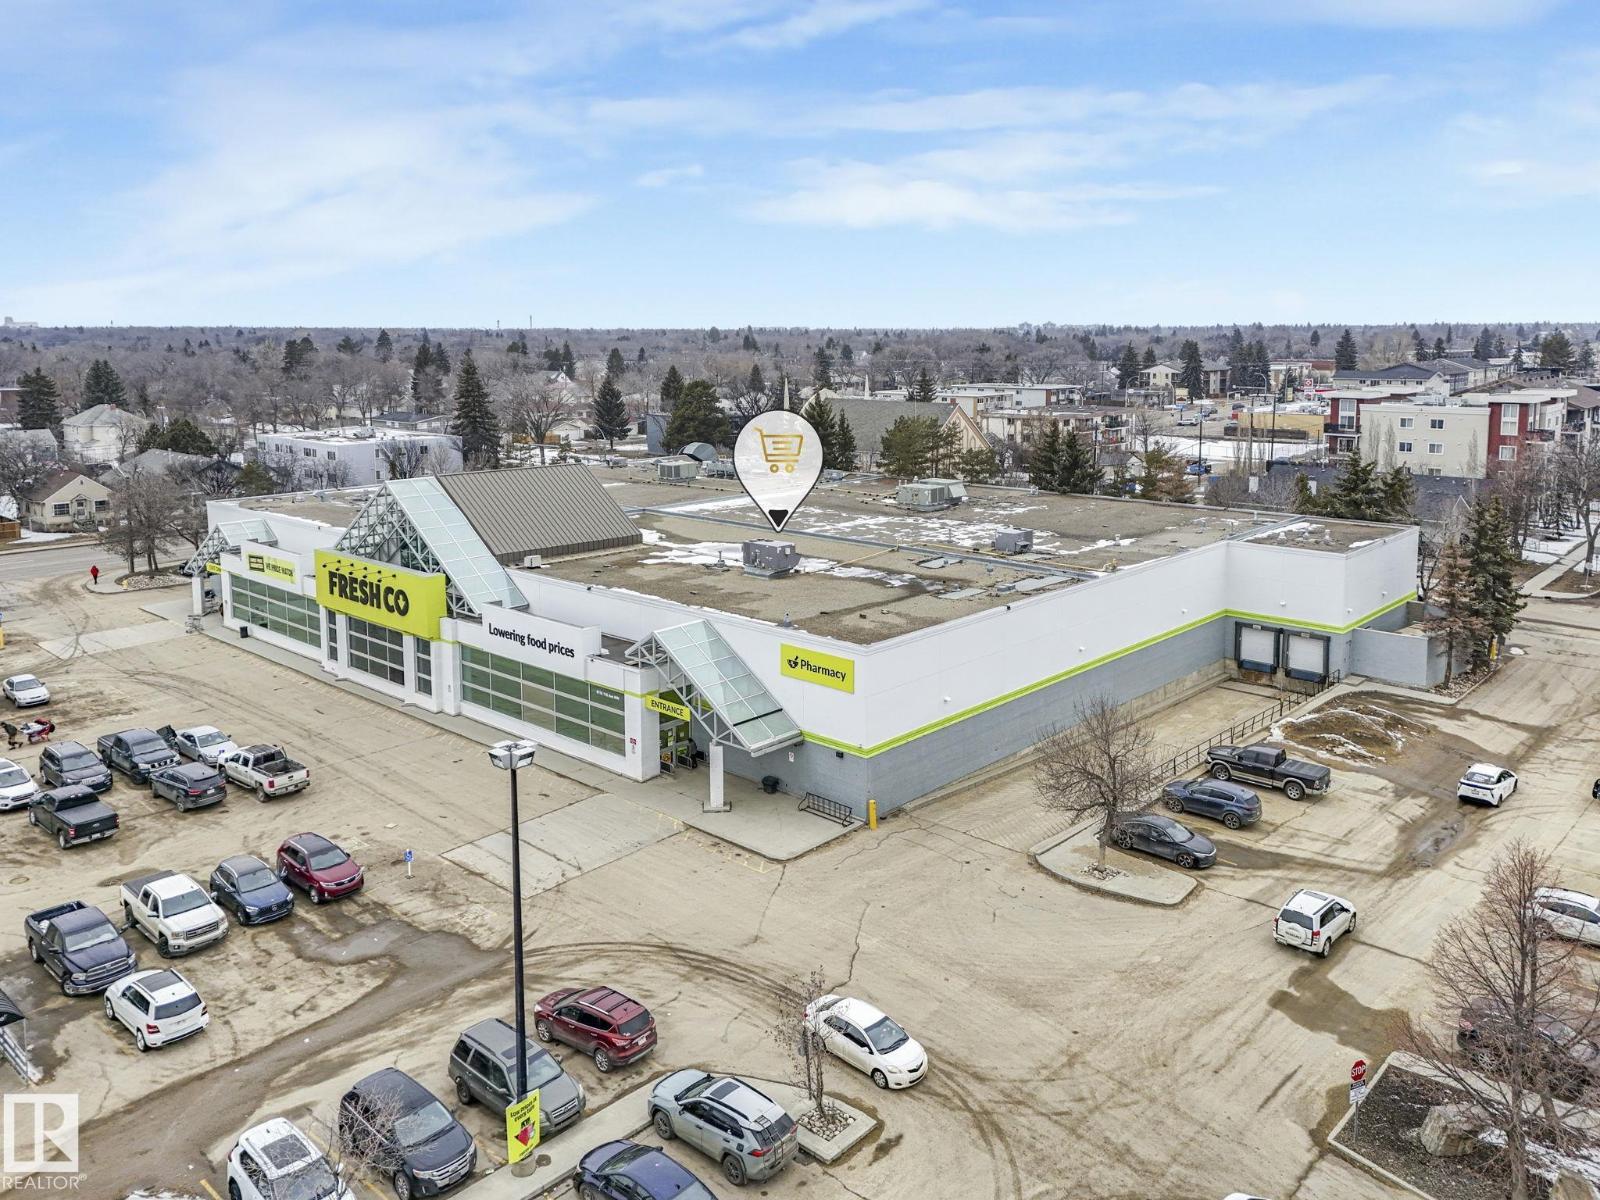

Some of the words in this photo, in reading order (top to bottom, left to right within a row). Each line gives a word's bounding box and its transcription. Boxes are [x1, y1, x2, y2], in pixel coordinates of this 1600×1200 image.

[328, 570, 382, 610] FRESH
[383, 586, 410, 617] CO
[488, 622, 526, 646] Lowering
[527, 633, 547, 650] food
[548, 641, 575, 659] prices
[800, 659, 847, 682] Pharmacy
[651, 699, 684, 717] ENTRANCE
[1351, 1064, 1366, 1077] STOP
